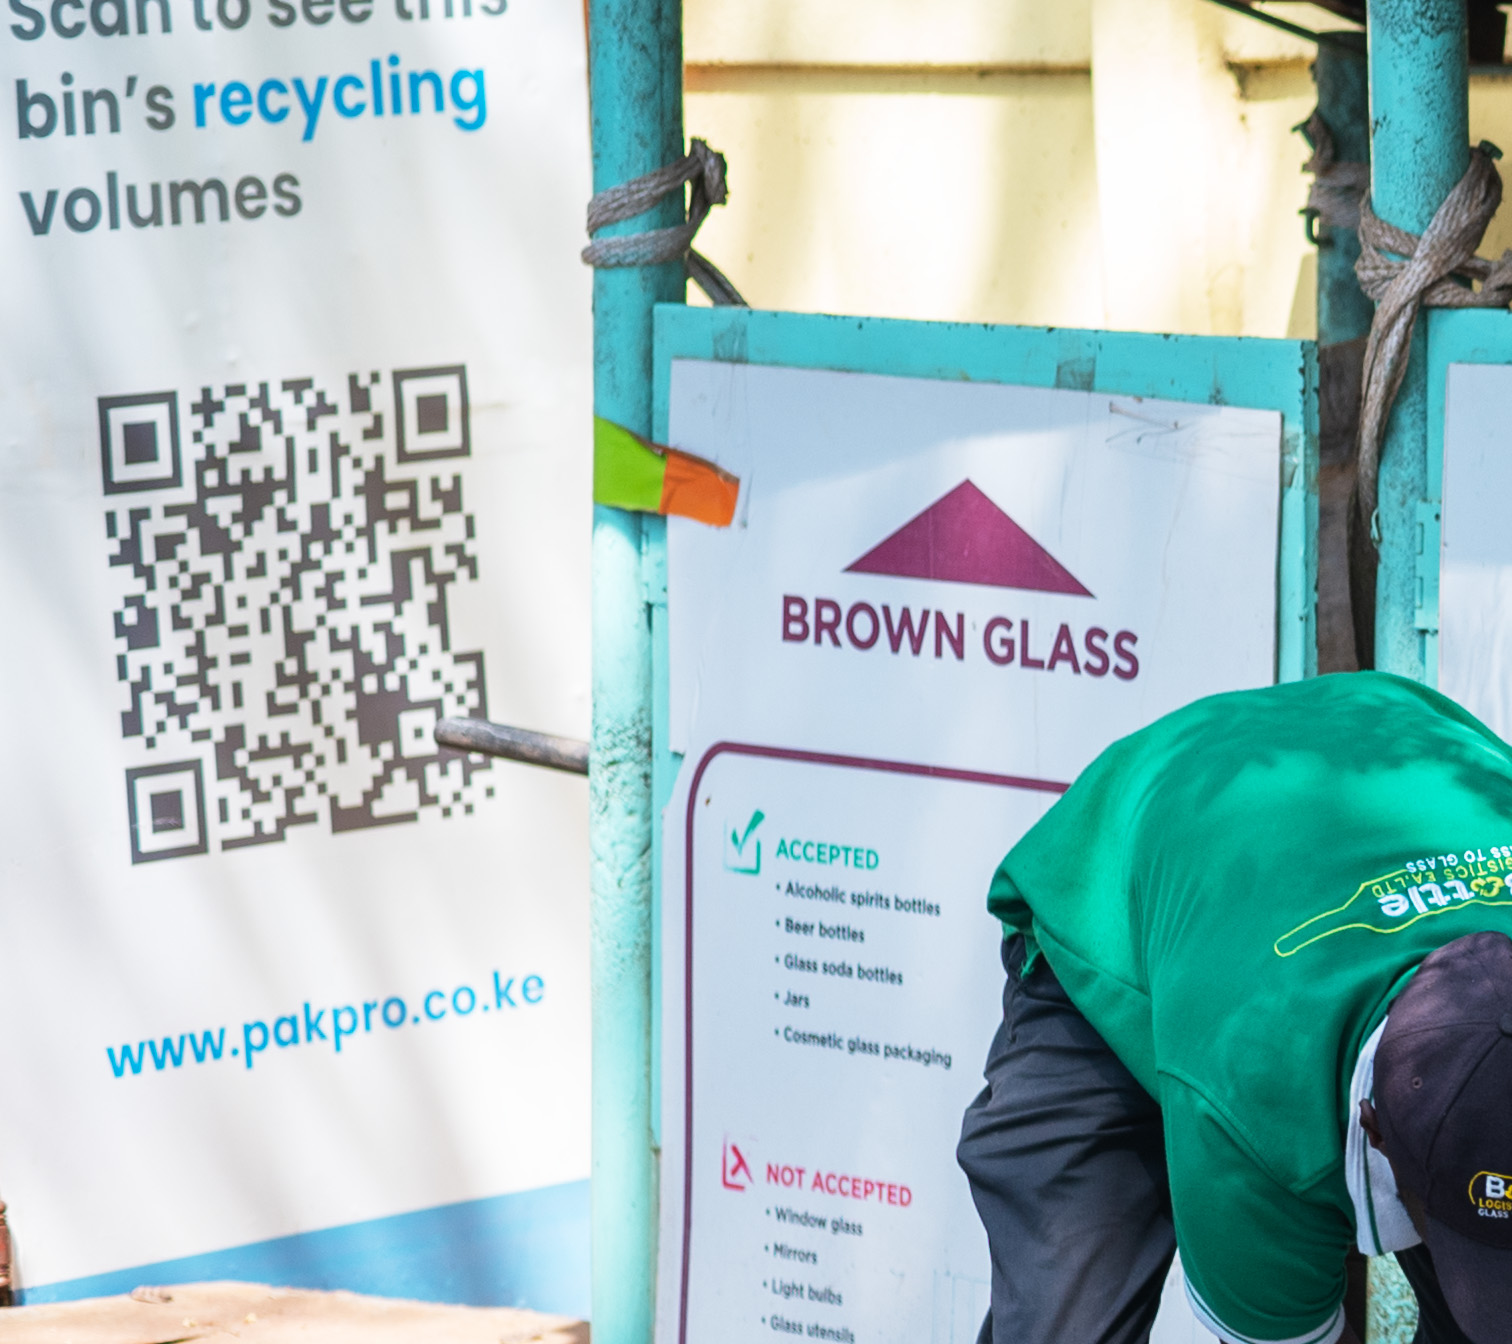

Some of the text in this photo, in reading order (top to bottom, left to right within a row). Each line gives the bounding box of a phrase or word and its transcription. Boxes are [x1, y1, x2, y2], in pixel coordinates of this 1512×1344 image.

[193, 59, 486, 141] recycling
[19, 171, 301, 236] volumes
[782, 595, 1138, 681] BROWN GLASS
[776, 838, 879, 870] ACCEPTED
[106, 970, 544, 1078] www.pakpro.co.ke
